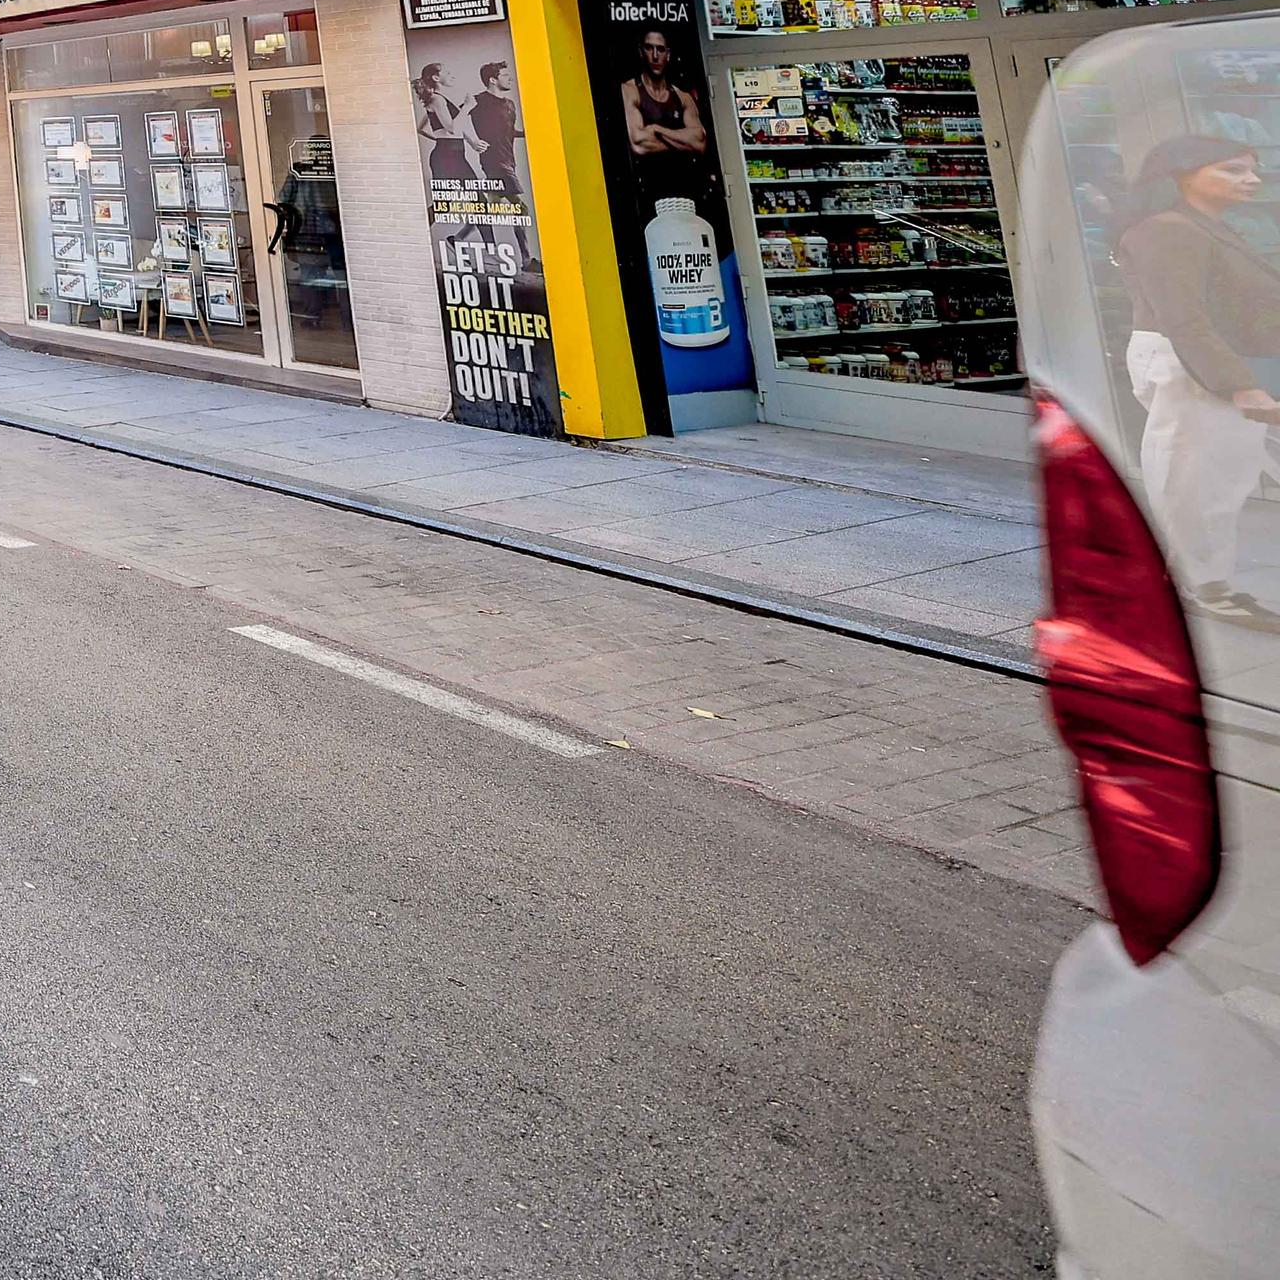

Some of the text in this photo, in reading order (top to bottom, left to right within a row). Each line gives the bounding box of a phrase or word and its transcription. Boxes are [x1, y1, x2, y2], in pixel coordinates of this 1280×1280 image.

[743, 100, 769, 109] VISA
[430, 178, 505, 191] FITNESS, DIETÉTICA
[431, 190, 478, 202] HERBOLARIO
[433, 202, 522, 215] LAS MEJORES MARCAS
[434, 214, 532, 227] DIETAS Y ENTRENAMIENTO
[438, 239, 517, 277] LET'S
[656, 253, 712, 269] 100% PURE
[668, 269, 704, 284] WHEY
[442, 272, 515, 311] DO IT
[446, 305, 550, 340] TOGETHER
[450, 330, 535, 373] DON'T
[455, 363, 532, 407] QUIT!
